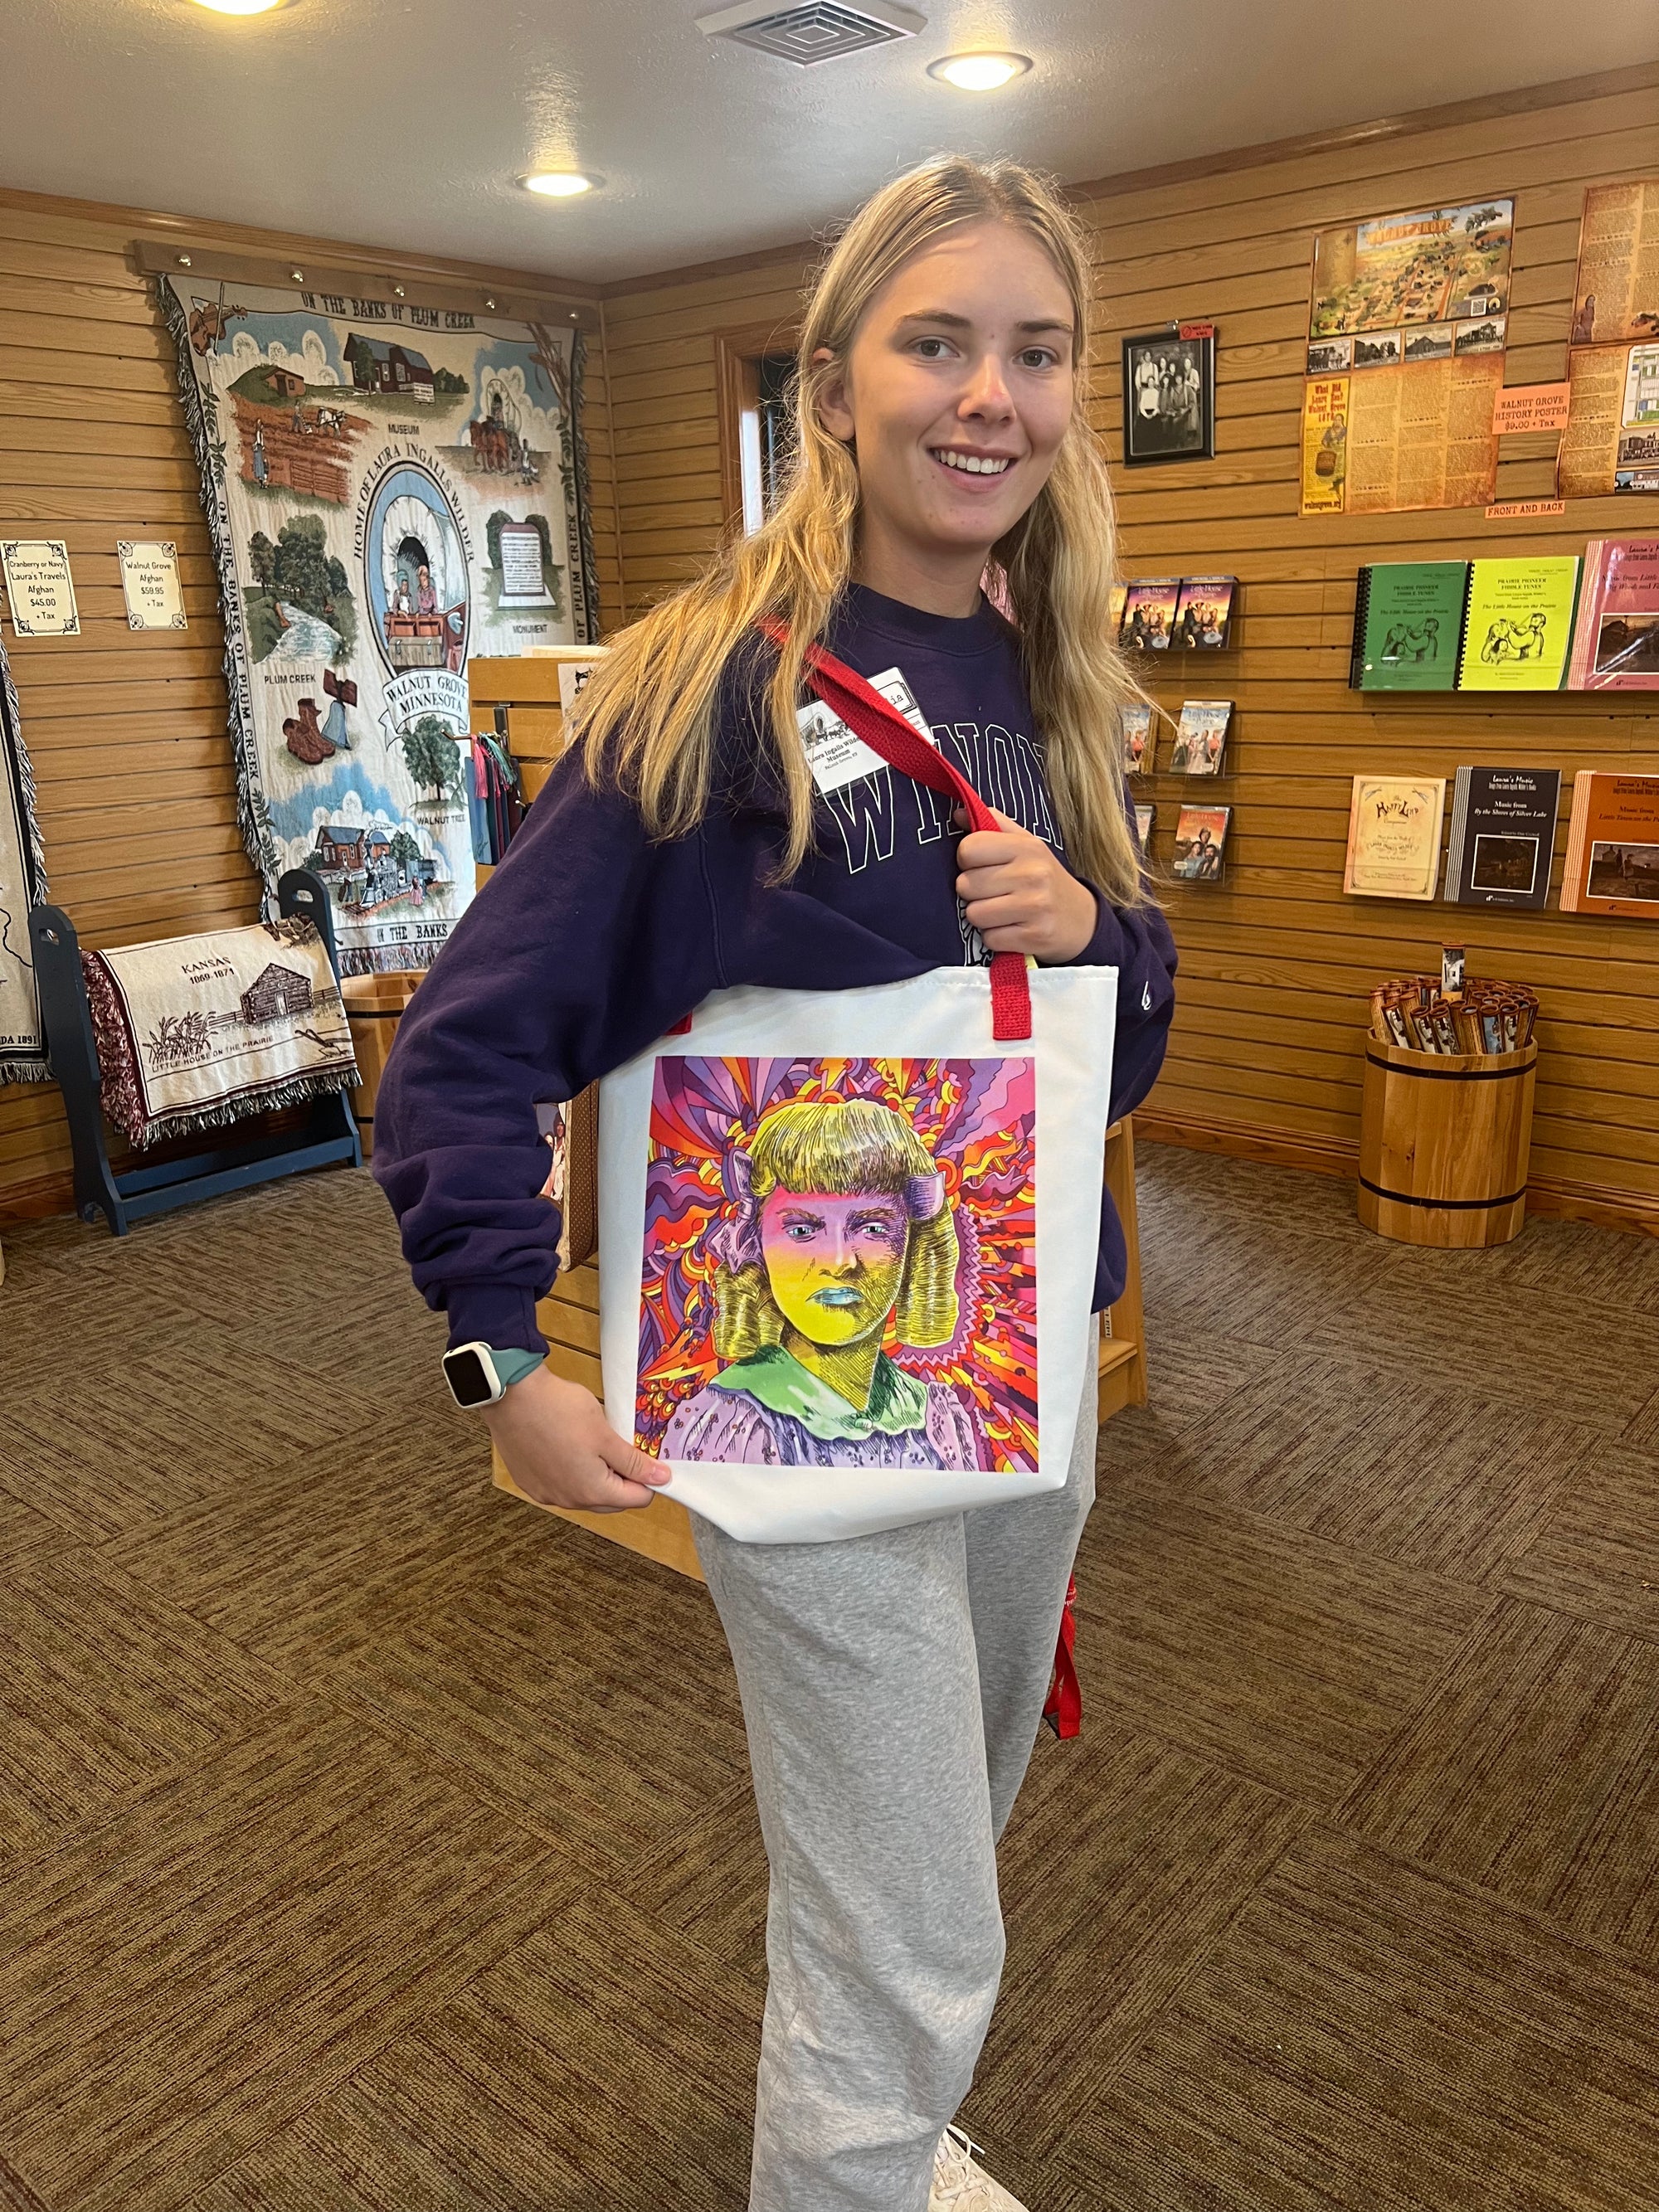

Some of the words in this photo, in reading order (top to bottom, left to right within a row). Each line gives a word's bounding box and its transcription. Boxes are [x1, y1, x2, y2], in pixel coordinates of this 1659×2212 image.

[300, 292, 316, 309] ON
[319, 293, 346, 315] THE
[350, 298, 387, 319] BANKS
[391, 304, 404, 321] OF
[410, 306, 439, 328] PLUM
[445, 311, 475, 329] CREEK
[1501, 398, 1534, 409] WALNUT
[1535, 396, 1564, 406] GROVE
[1495, 409, 1533, 421] HISTORY
[1535, 406, 1568, 417] POSTER
[387, 423, 421, 435] MUSEUM
[1505, 420, 1530, 432] $9.00
[1540, 419, 1555, 427] Tax
[367, 445, 401, 481] LAURA
[406, 442, 453, 493] INGALLS
[359, 478, 373, 503] OF
[218, 501, 228, 525] ON
[1487, 505, 1518, 517] FRONT
[1520, 503, 1538, 514] AND
[1540, 501, 1564, 512] BACK
[353, 503, 366, 560] HOME
[450, 491, 475, 563] WILDER
[568, 514, 580, 562] CREEK
[222, 533, 235, 569] THE
[9, 561, 40, 569] Cranberry
[48, 561, 64, 569] Navy
[125, 562, 150, 570] Walnut
[152, 562, 172, 570] Grove
[11, 571, 38, 581] Laura's
[38, 571, 66, 580] Travels
[139, 573, 163, 584] Afghan
[27, 585, 55, 596] Afghan
[140, 586, 164, 595] $59.95
[572, 571, 584, 612] PLUM
[30, 598, 56, 607] $45.00
[152, 599, 163, 607] Tax
[228, 581, 241, 634] BANKS
[41, 611, 56, 620] Tax
[512, 624, 548, 634] MONUMENT
[576, 619, 586, 639] OF
[235, 643, 245, 664] OF
[264, 675, 288, 685] PLUM
[289, 673, 317, 684] CREEK
[239, 674, 251, 719] PLUM
[387, 676, 431, 702] WALNUT
[437, 676, 468, 700] GROVE
[399, 693, 462, 717] MINNESOTA
[244, 729, 259, 780] CREEK
[807, 753, 825, 764] Laura
[825, 745, 844, 757] Ingalls
[826, 749, 851, 763] Museum
[1492, 774, 1515, 783] Laura's
[1515, 775, 1534, 784] Music
[416, 815, 450, 825] WALNUT
[450, 814, 465, 824] TREE
[1474, 808, 1481, 817] By
[1509, 809, 1516, 818] of
[389, 926, 408, 941] THE
[416, 923, 448, 939] BANKS
[181, 956, 231, 975] KANSAS
[17, 1035, 37, 1045] 1891
[152, 1060, 182, 1073] LITTLE
[183, 1054, 207, 1065] HOUSE
[212, 1049, 223, 1057] ON
[226, 1043, 241, 1053] THE
[242, 1037, 274, 1048] PRAIRIE
